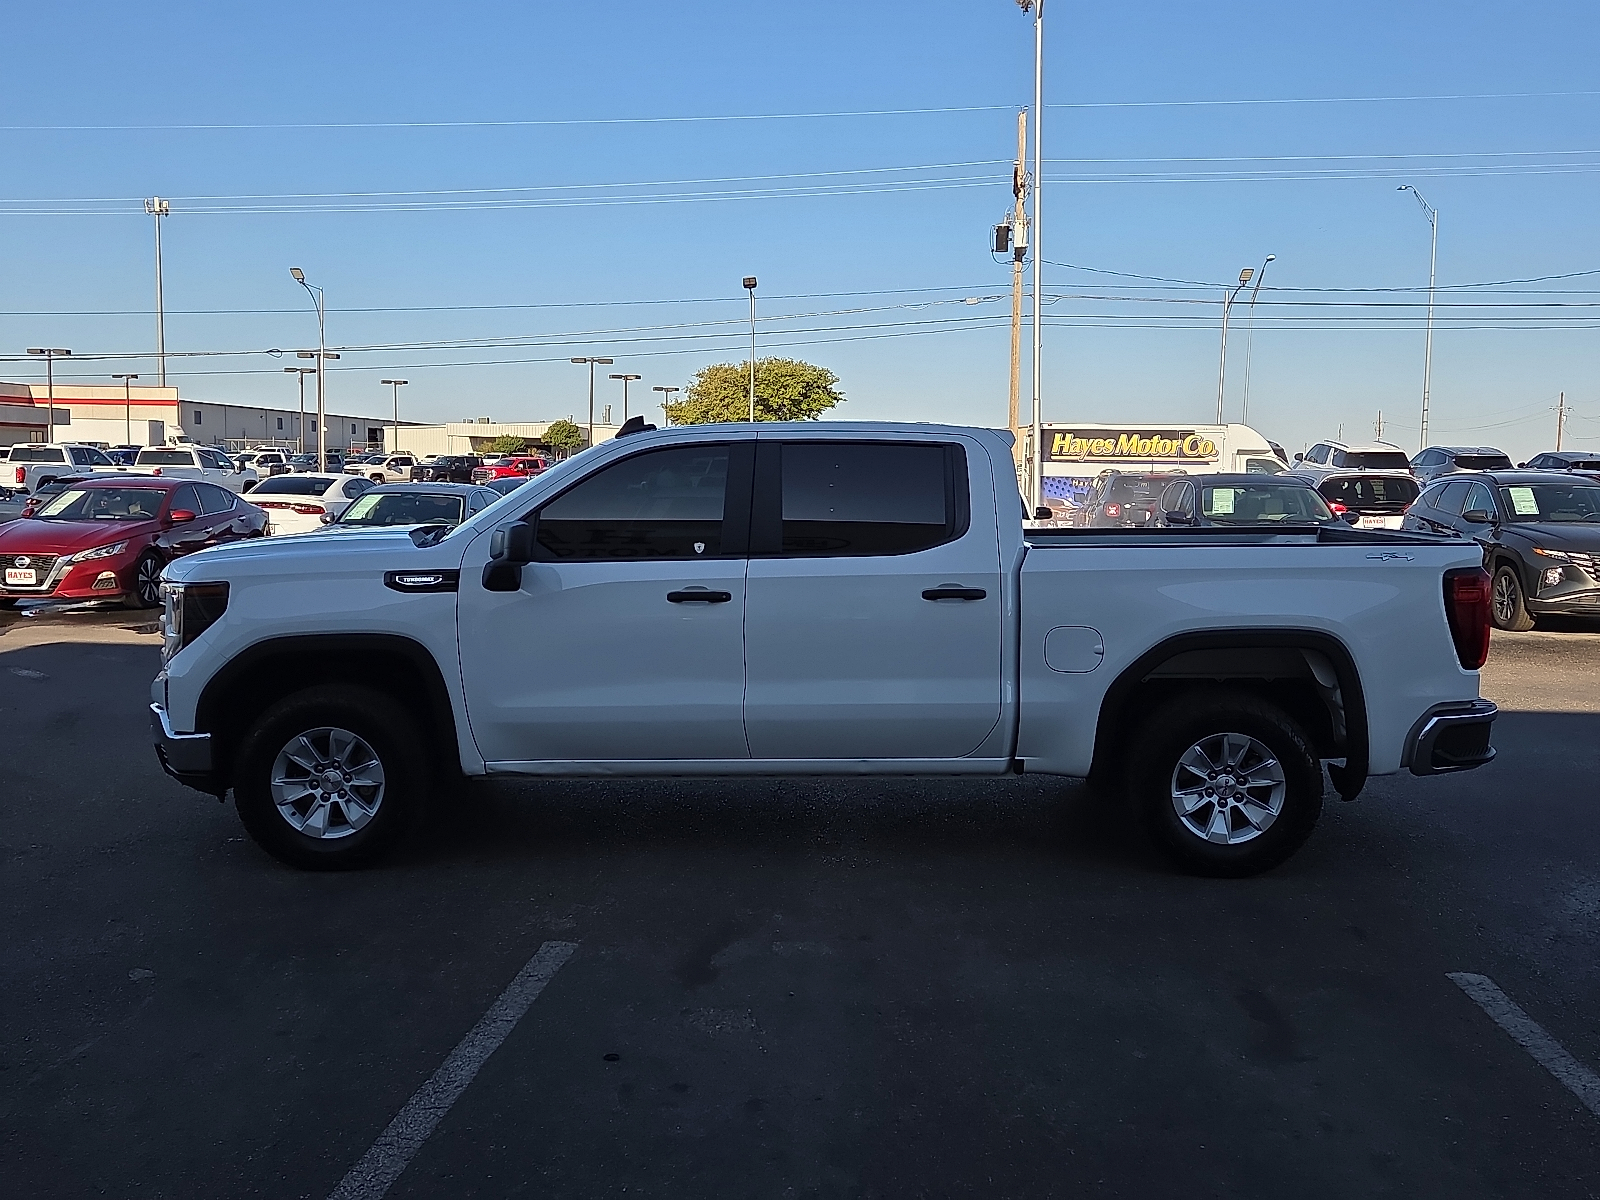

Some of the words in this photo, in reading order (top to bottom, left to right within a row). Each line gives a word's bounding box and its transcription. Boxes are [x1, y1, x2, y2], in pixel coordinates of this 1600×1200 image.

[1051, 432, 1115, 461] Hayes
[1116, 433, 1180, 456] Motor
[1182, 434, 1219, 457] Co.
[7, 571, 33, 579] HAYES
